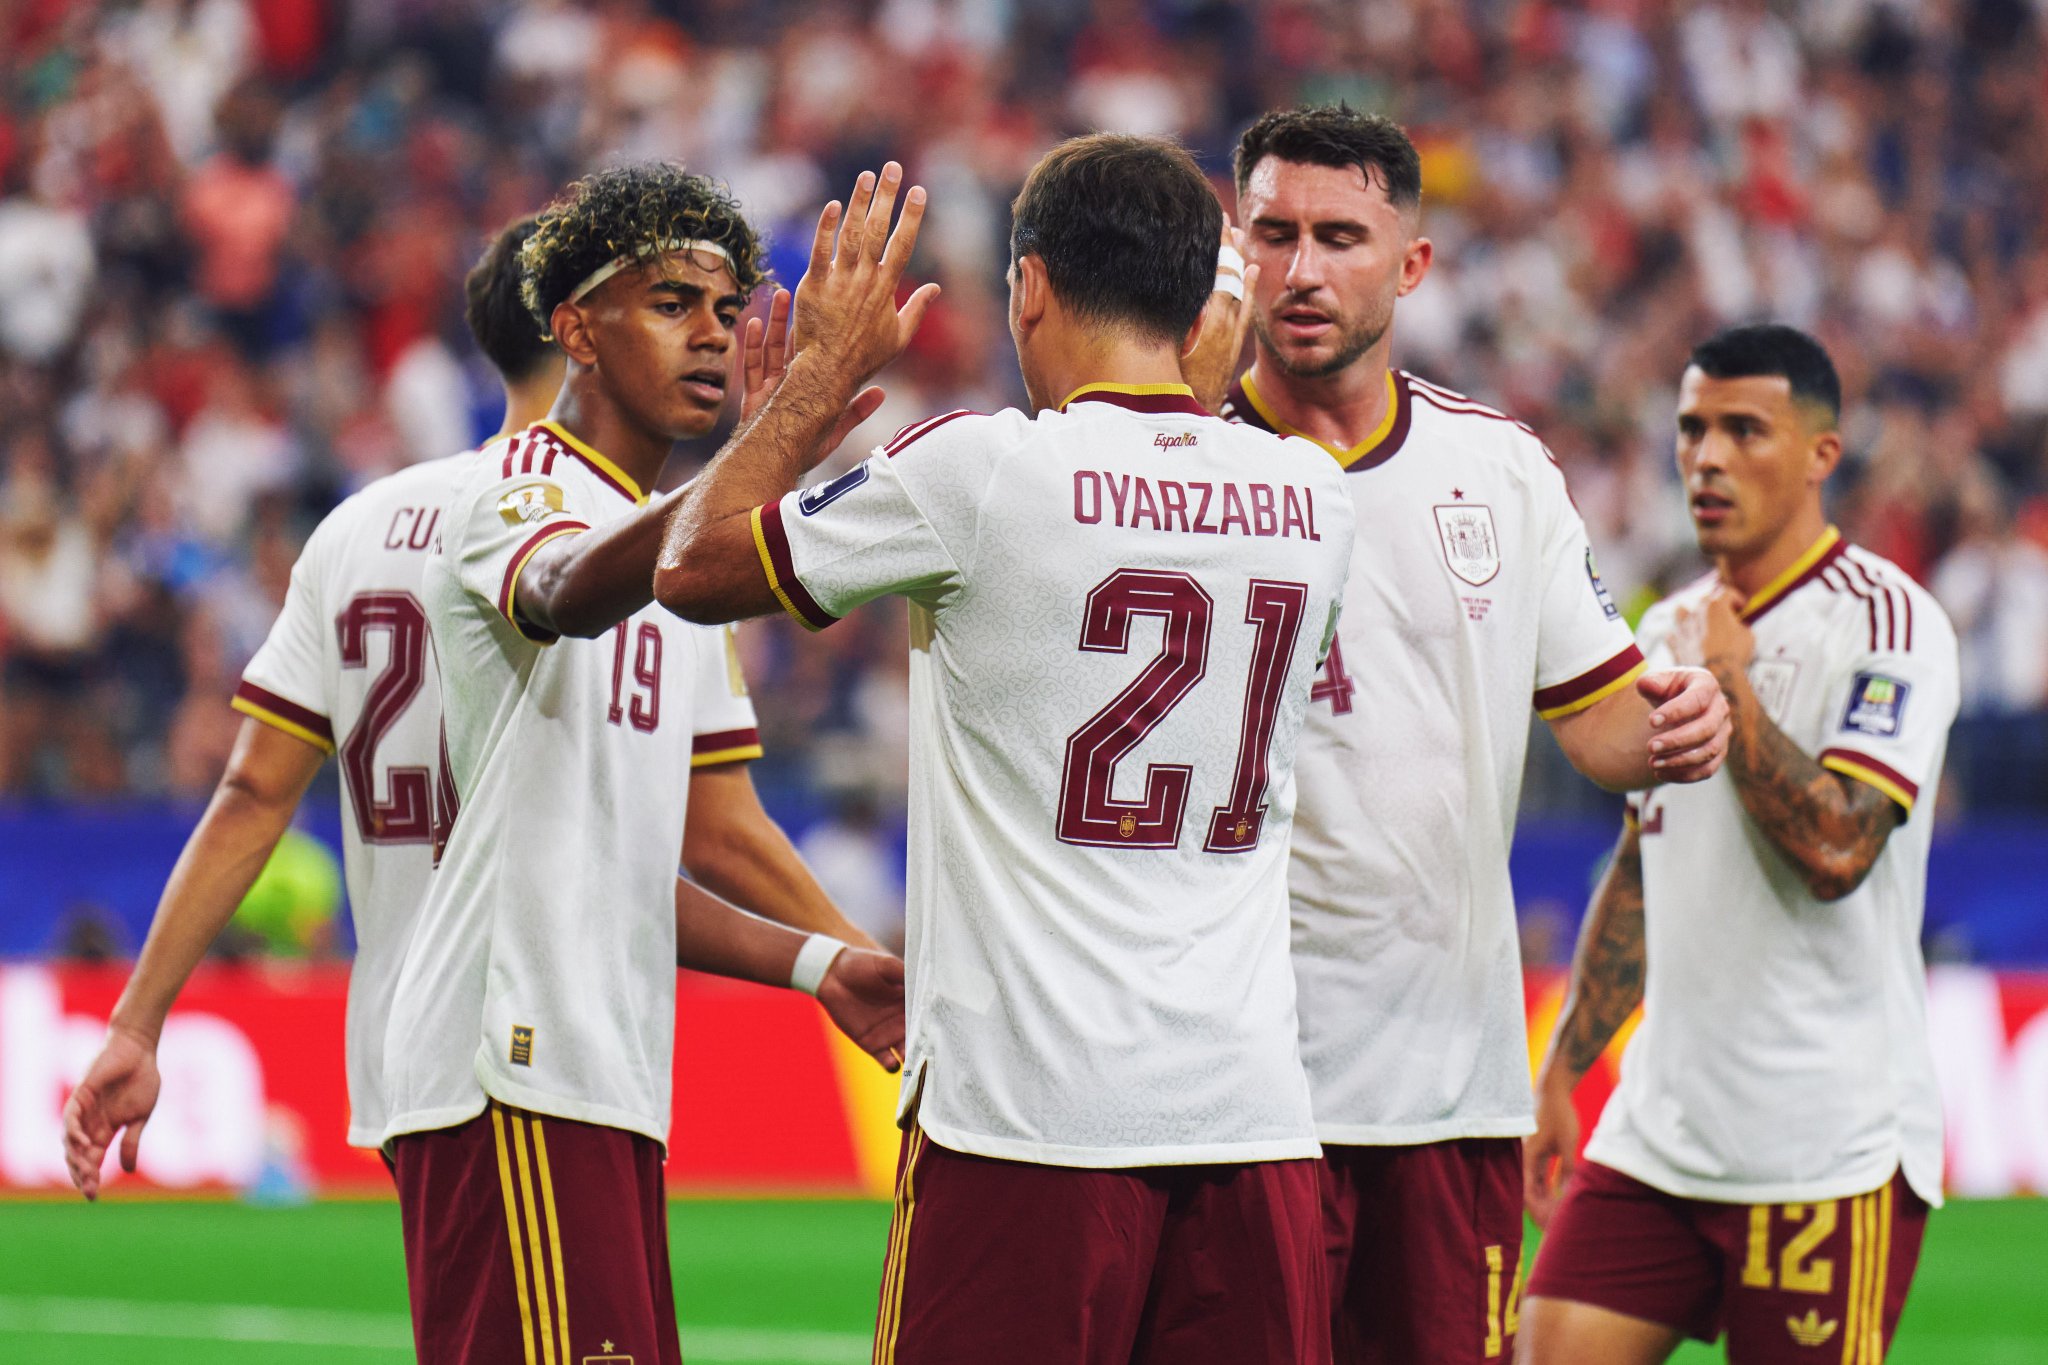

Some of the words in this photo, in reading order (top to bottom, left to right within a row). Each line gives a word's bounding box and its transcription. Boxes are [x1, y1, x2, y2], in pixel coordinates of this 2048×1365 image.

[1154, 432, 1198, 452] España
[384, 506, 443, 555] CU
[1073, 470, 1321, 542] OYARZABAL
[607, 618, 662, 734] 19
[1056, 568, 1308, 853] 21
[335, 590, 461, 870] 2
[1742, 1200, 1837, 1294] 12
